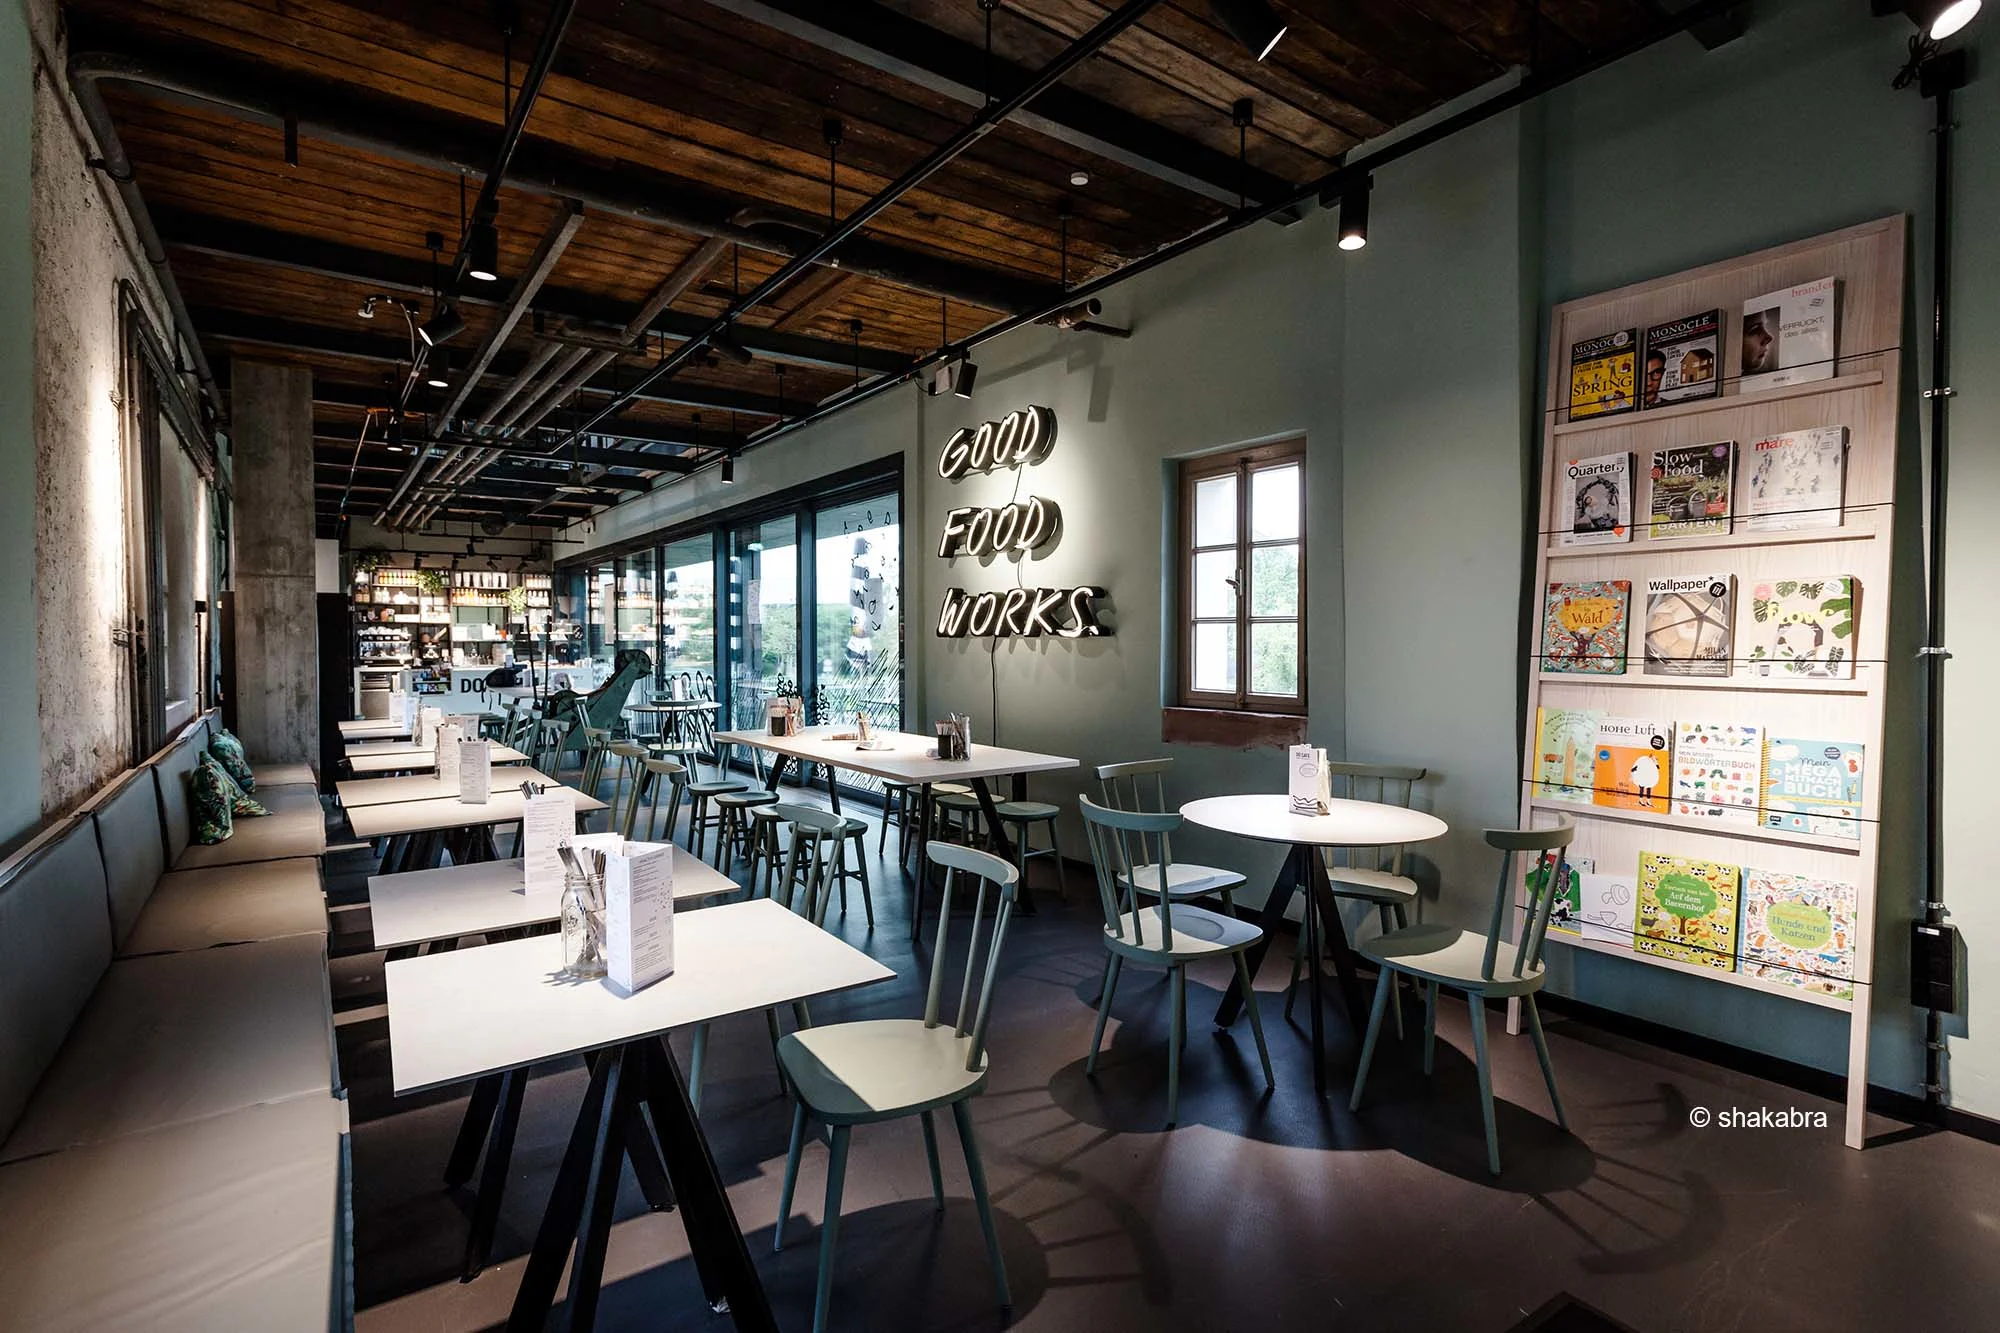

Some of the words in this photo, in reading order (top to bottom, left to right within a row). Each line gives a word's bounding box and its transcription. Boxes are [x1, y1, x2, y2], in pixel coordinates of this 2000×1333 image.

[1650, 316, 1711, 339] MONOCLE
[1574, 338, 1616, 354] MONOC
[1573, 376, 1633, 397] SPRING
[938, 404, 1050, 479] GOOD
[1755, 438, 1793, 451] mare
[1653, 450, 1693, 466] Slow
[1664, 459, 1705, 478] Food
[938, 496, 1056, 558] FOOD
[1657, 518, 1717, 531] GARTEN
[1572, 610, 1603, 624] Wald
[1784, 762, 1841, 778] MEGA
[1800, 757, 1831, 767] Mein
[1784, 782, 1842, 800] BUCH
[1772, 916, 1805, 930] Hunde
[1781, 927, 1816, 941] Katzen
